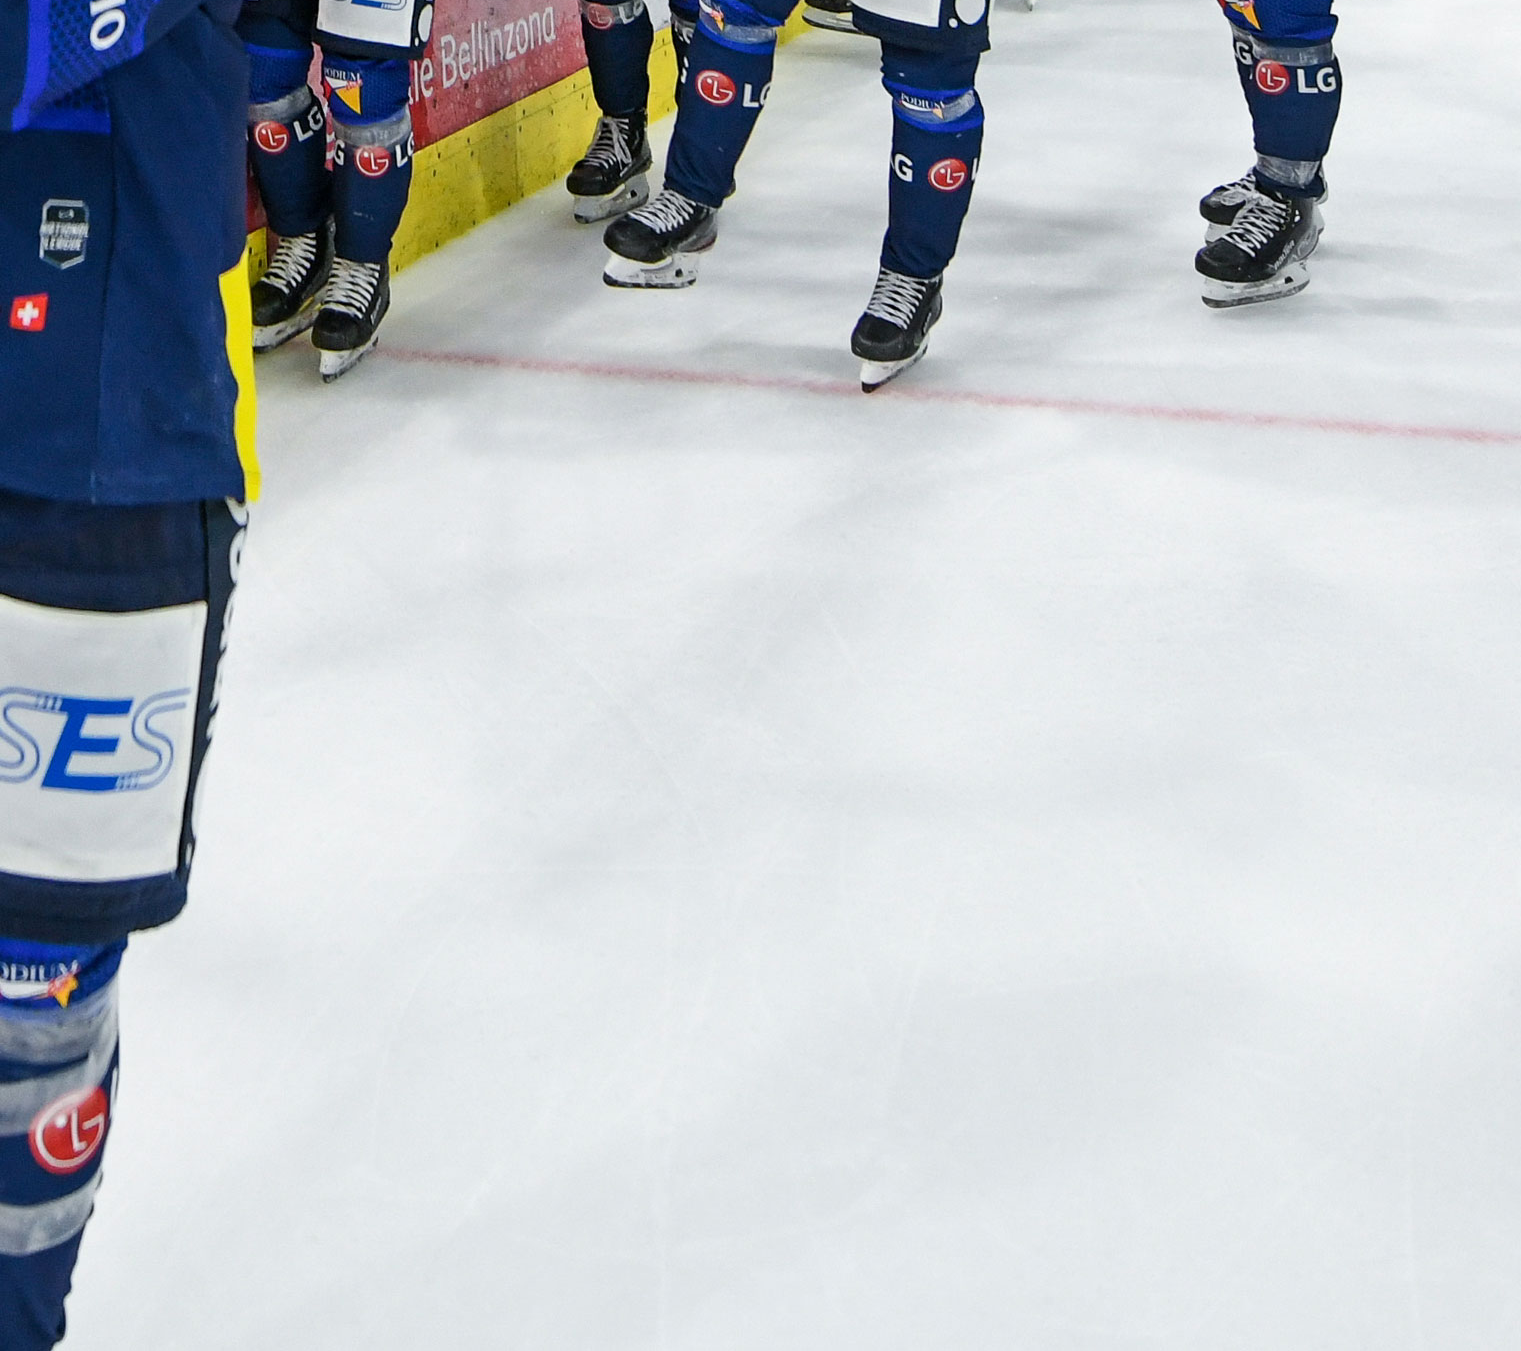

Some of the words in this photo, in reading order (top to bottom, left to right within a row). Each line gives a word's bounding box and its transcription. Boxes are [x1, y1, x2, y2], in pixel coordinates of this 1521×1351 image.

[441, 7, 557, 89] Bellinzona
[1296, 65, 1337, 95] LG
[291, 109, 326, 144] LG
